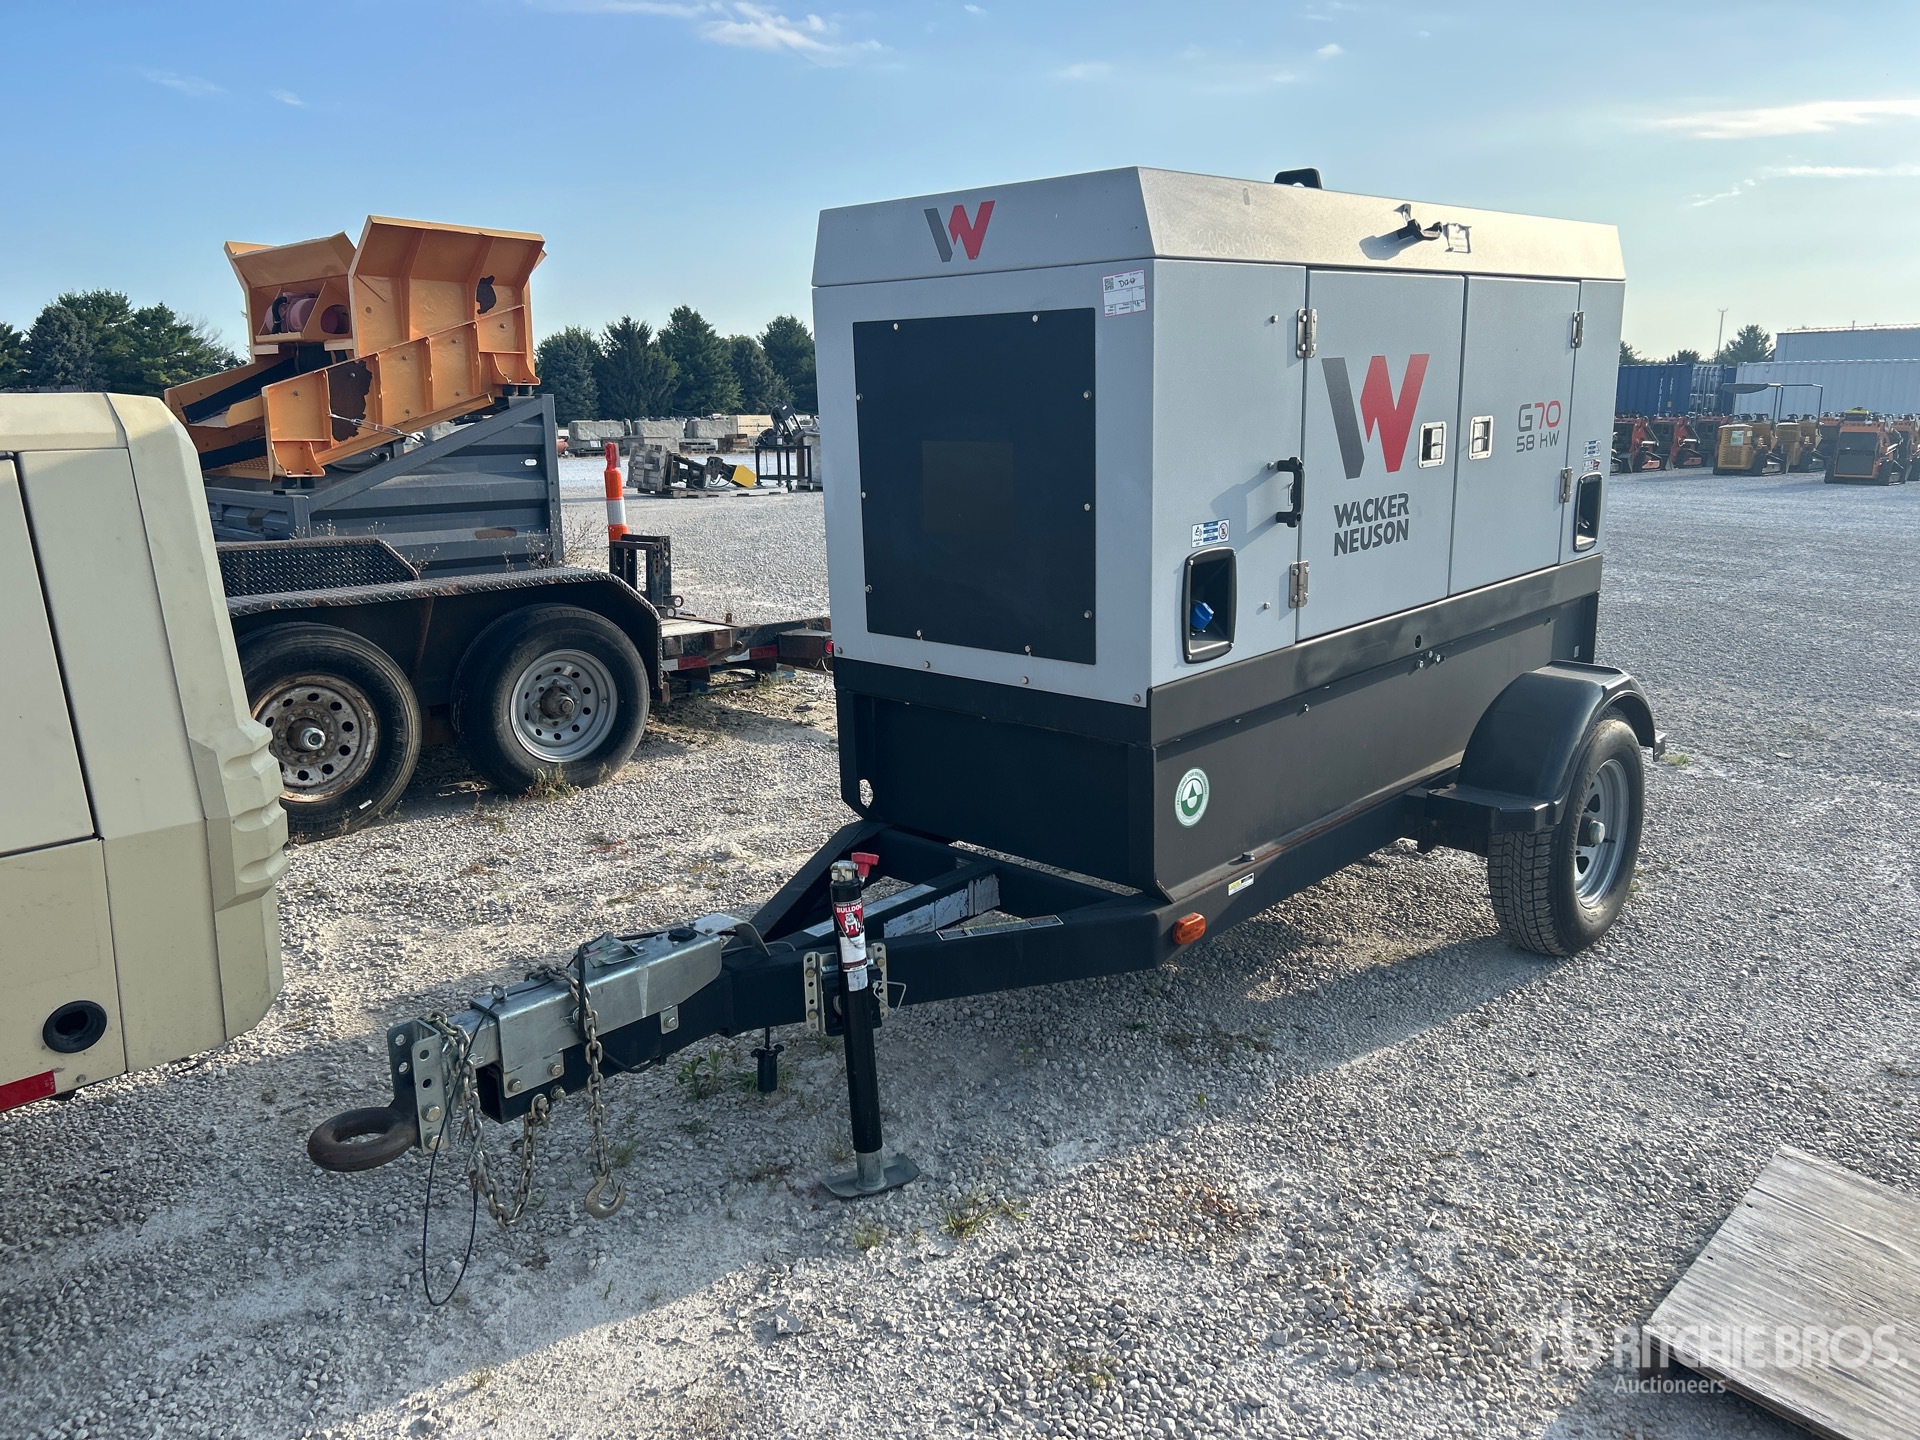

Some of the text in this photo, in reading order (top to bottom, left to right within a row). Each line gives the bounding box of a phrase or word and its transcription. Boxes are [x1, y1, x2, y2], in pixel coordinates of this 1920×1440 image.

[1517, 400, 1562, 432] G70
[1516, 435, 1535, 453] 58
[1333, 492, 1410, 528] WACKER
[1333, 518, 1410, 557] NEUSON
[836, 902, 863, 914] BULLDOG
